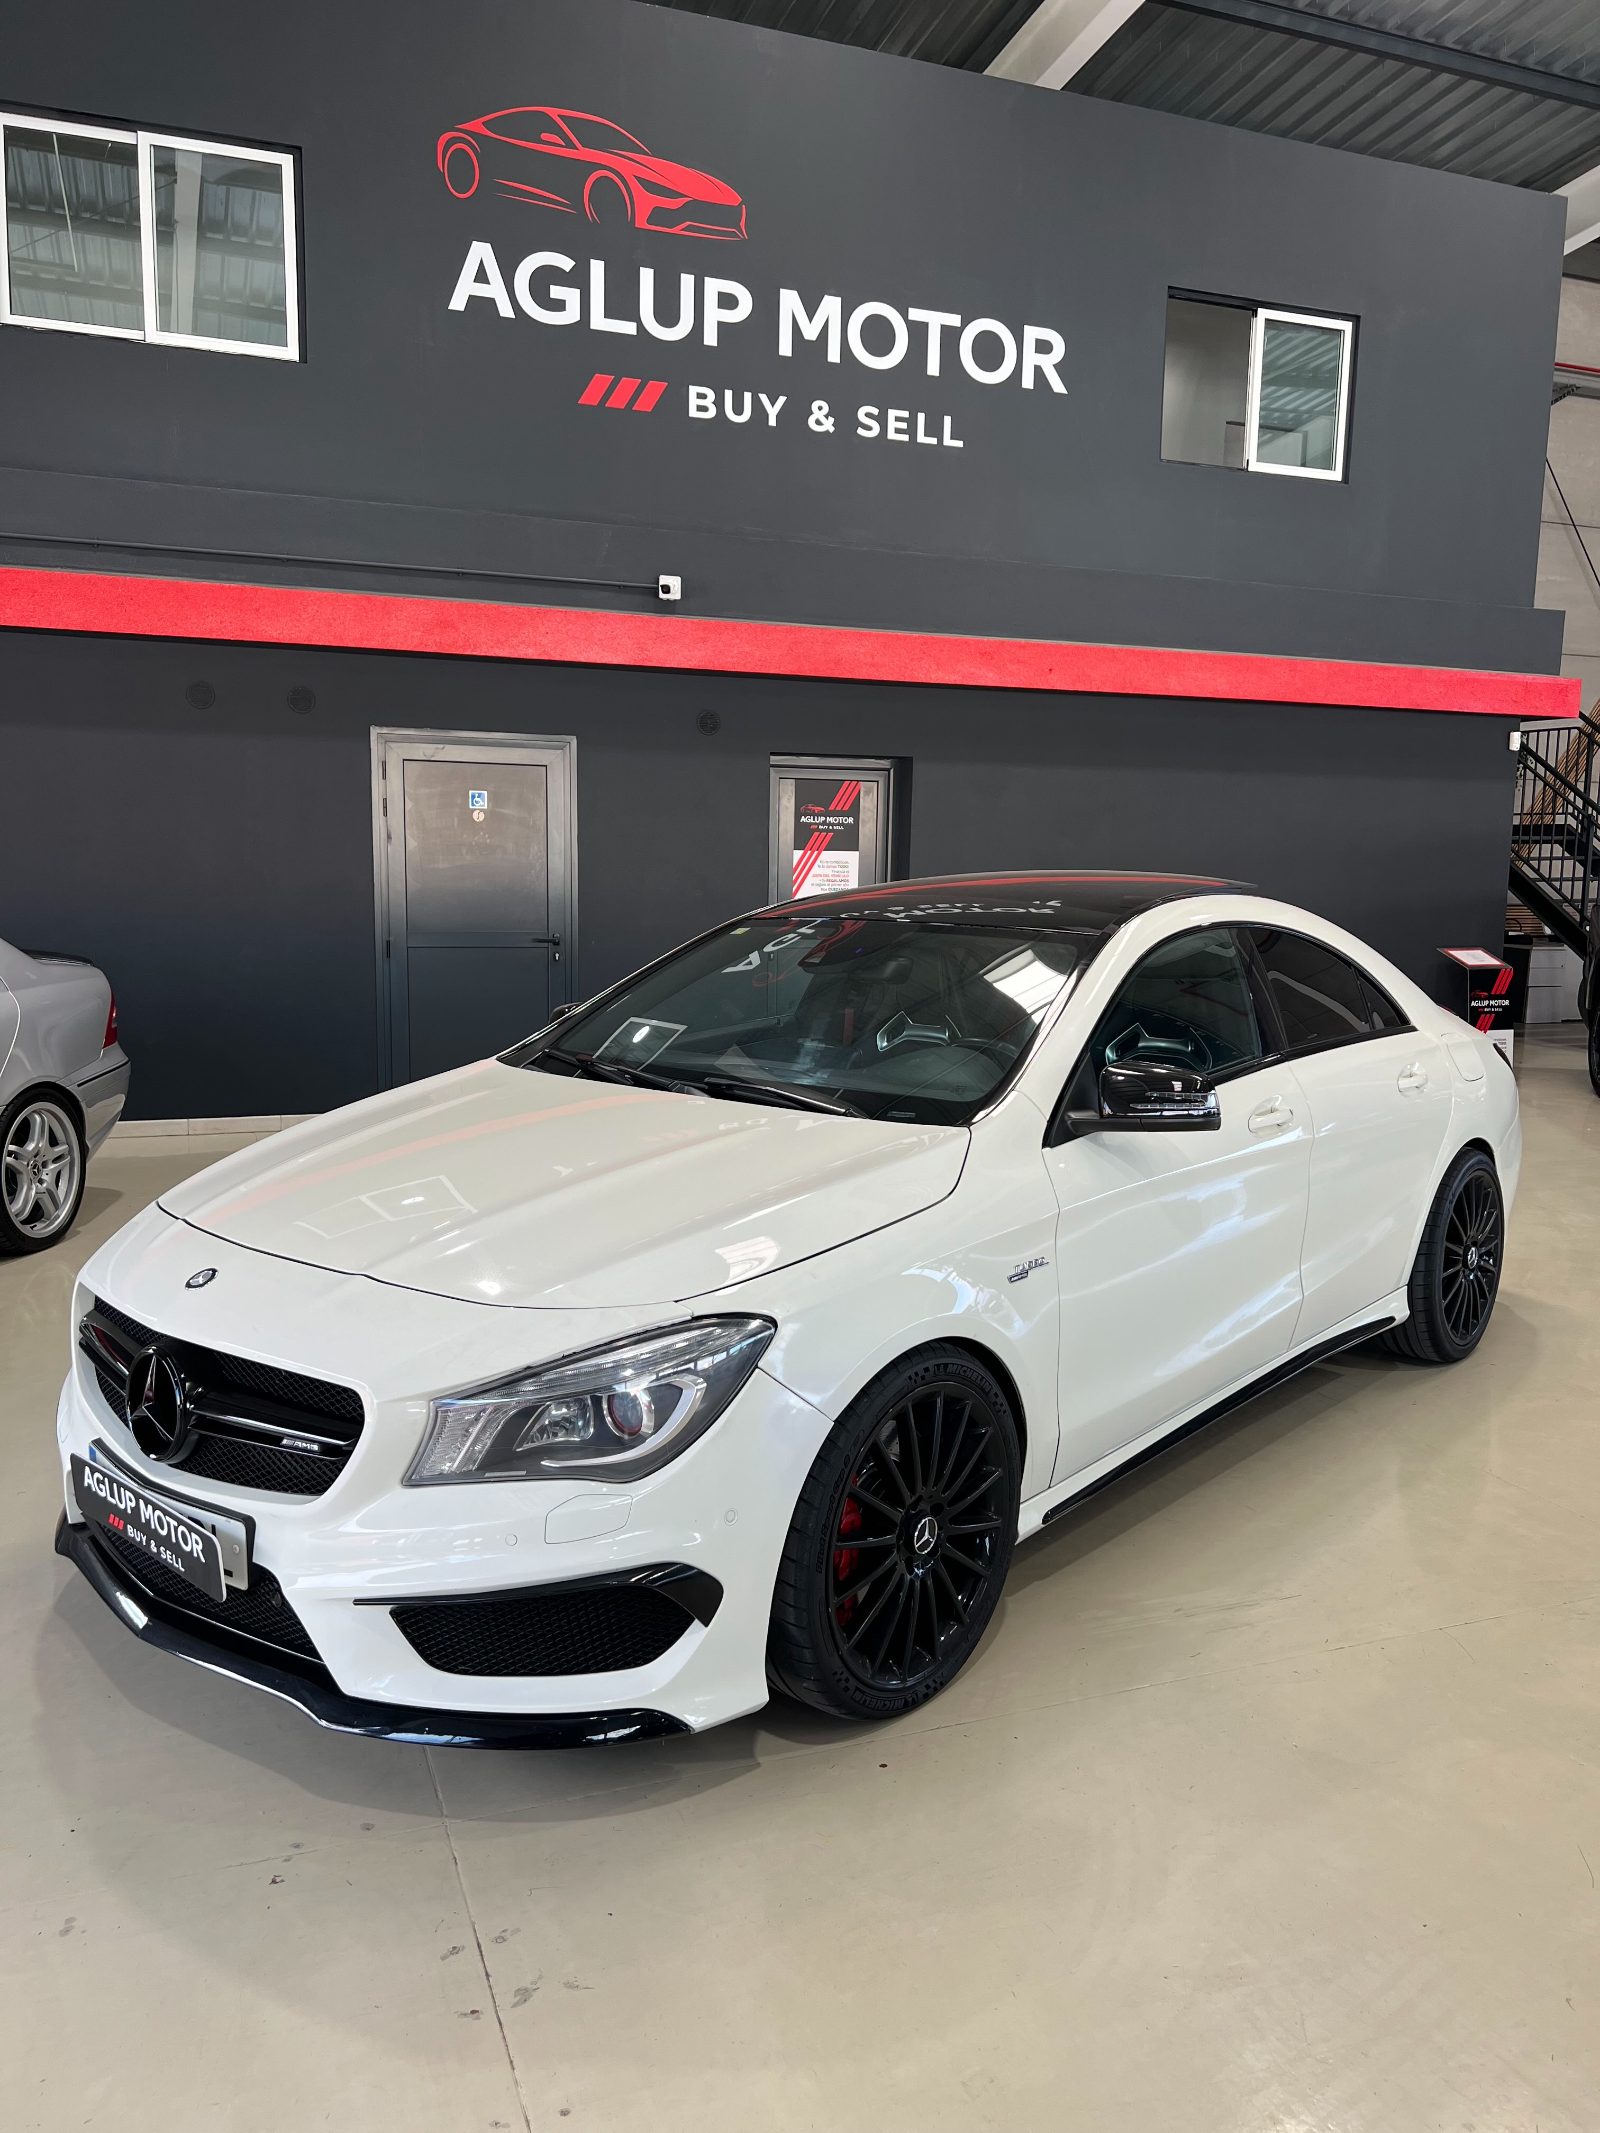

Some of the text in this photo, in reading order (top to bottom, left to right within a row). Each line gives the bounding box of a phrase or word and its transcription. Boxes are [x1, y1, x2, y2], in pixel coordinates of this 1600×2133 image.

[448, 241, 1069, 394] AGLUP MOTOR
[689, 385, 963, 447] BUY & SELL
[800, 815, 854, 824] AGLUP MOTOR
[1490, 999, 1510, 1007] MOTOR
[84, 1465, 206, 1563] AGLUP MOTOR
[127, 1524, 185, 1572] BUY & SELL
